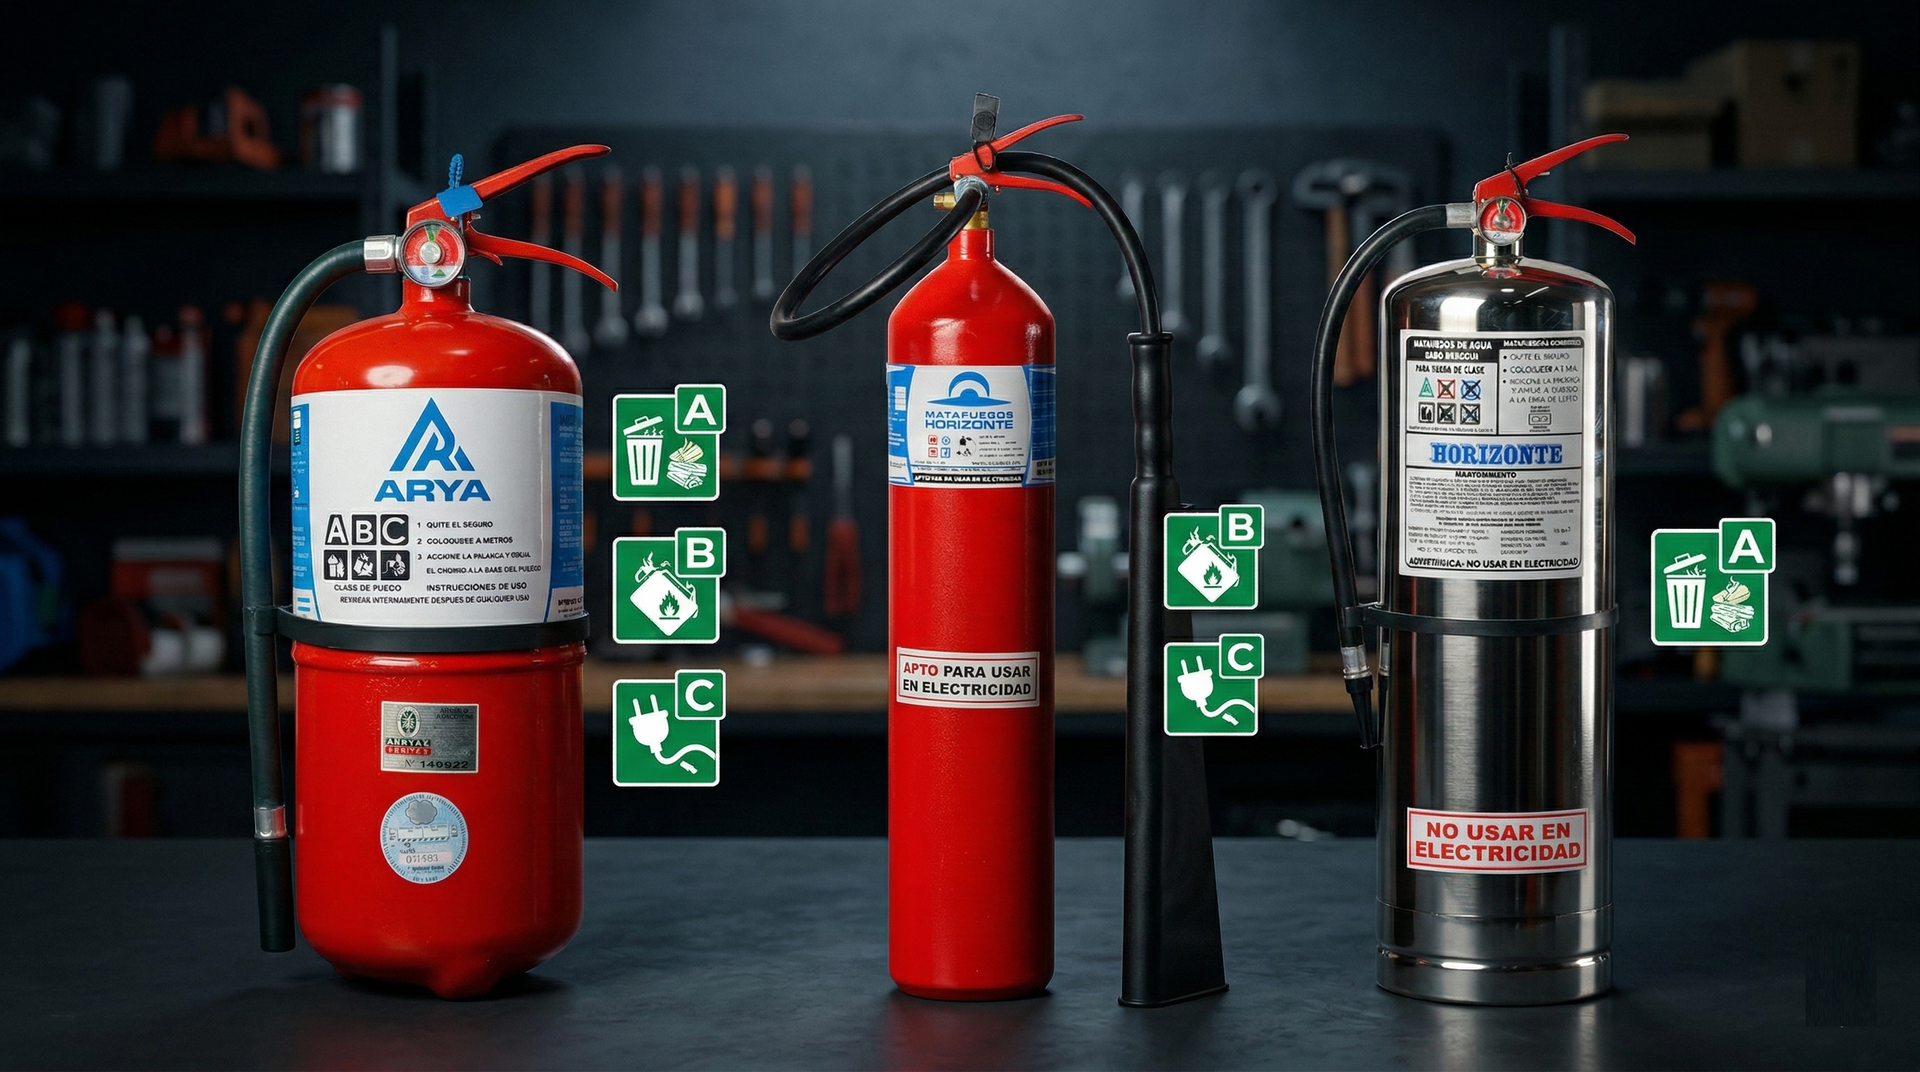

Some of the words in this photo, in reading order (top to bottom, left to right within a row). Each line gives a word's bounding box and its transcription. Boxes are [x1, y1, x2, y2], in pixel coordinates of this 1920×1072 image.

[1456, 341, 1468, 350] DE
[1469, 341, 1492, 350] AGUA
[925, 410, 1014, 420] MATAFUEGOS
[925, 419, 1014, 430] HORIZONTE
[1430, 442, 1564, 466] HORIZONTE
[374, 479, 492, 502] ARYA
[426, 521, 450, 529] QUITE
[463, 520, 494, 528] SEGURO
[482, 536, 514, 544] METROS
[1466, 559, 1481, 568] NO
[1483, 559, 1508, 569] USAR
[1509, 559, 1522, 568] EN
[333, 583, 358, 592] CLASS
[359, 583, 371, 592] DE
[498, 583, 509, 591] DE
[510, 582, 527, 590] USO
[430, 596, 464, 604] DESPUES
[465, 596, 475, 604] DE
[903, 661, 939, 677] APTO
[943, 665, 986, 678] PARA
[991, 665, 1031, 678] USAR
[903, 679, 919, 692] EN
[922, 681, 1031, 696] ELECTRICIDAD
[420, 760, 469, 769] 140922
[1426, 821, 1459, 839] NO
[1467, 824, 1534, 841] USAR
[1542, 822, 1571, 840] EN
[1415, 841, 1581, 862] ELECTRICIDAD
